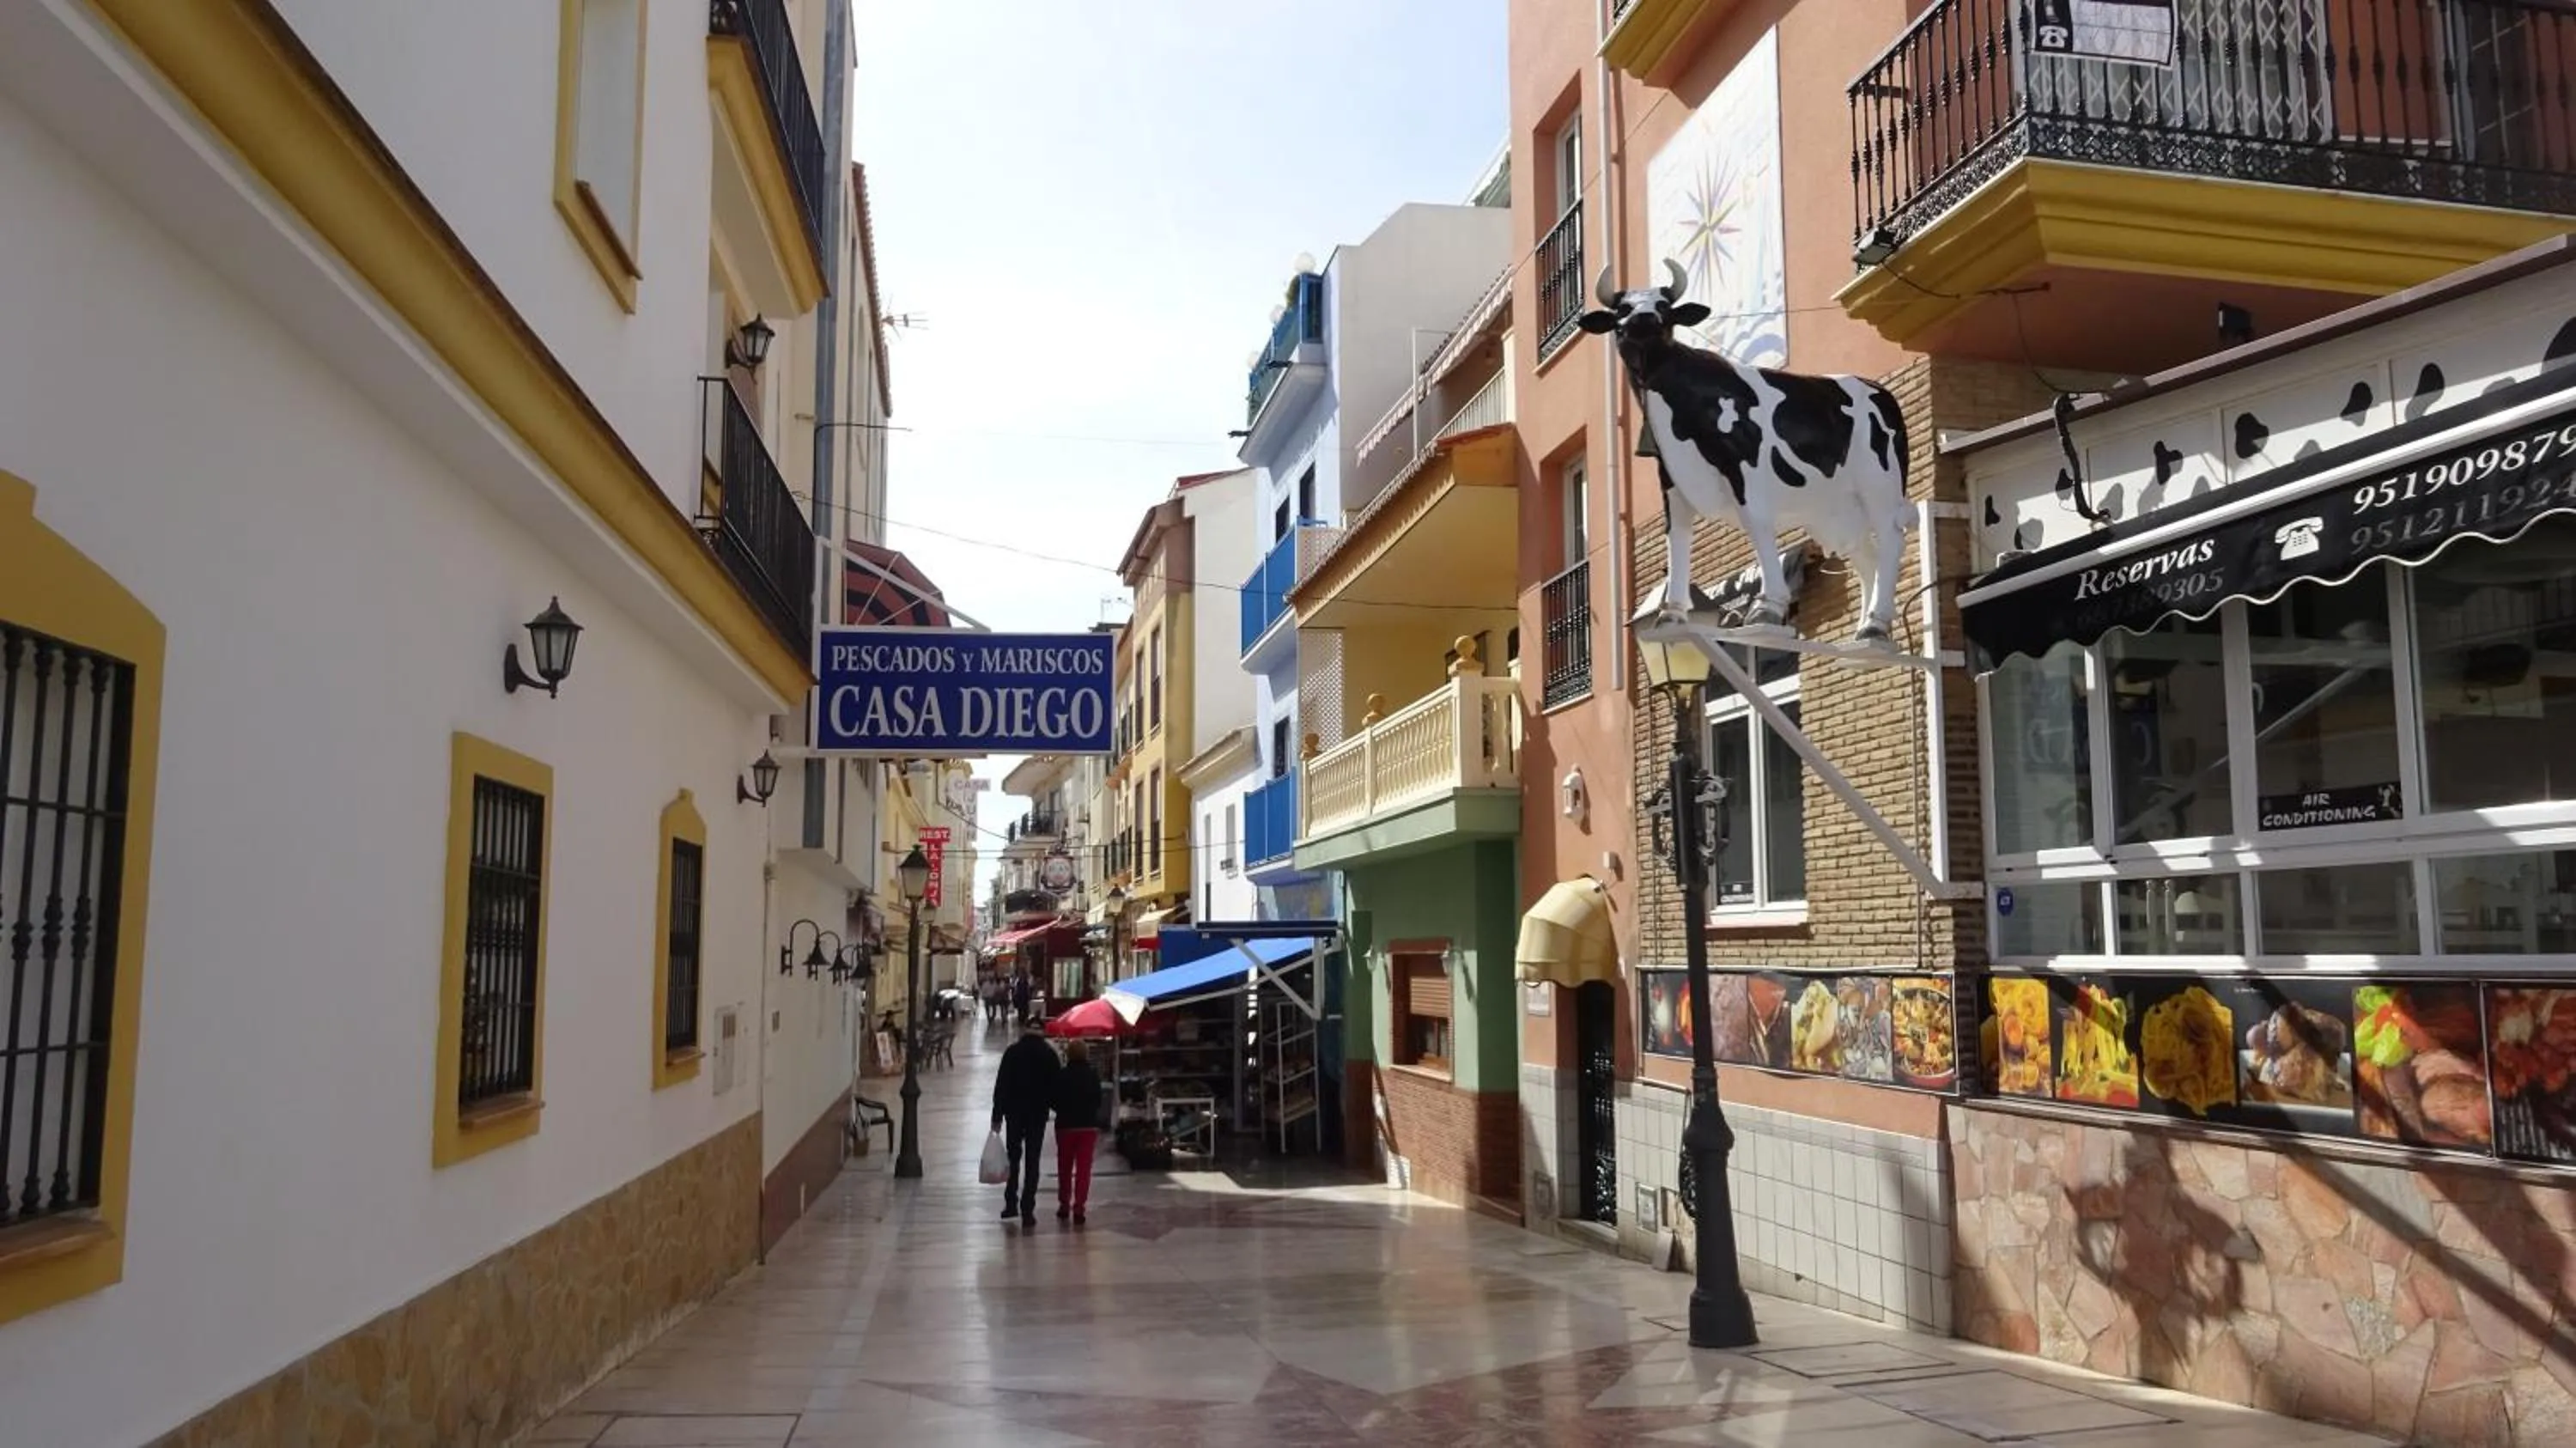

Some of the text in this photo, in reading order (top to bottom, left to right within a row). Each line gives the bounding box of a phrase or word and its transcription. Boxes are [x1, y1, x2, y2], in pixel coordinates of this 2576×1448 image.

[2352, 425, 2576, 515] 951909879
[2074, 538, 2215, 601] Reservas
[831, 646, 1103, 674] PESCADOS Y MARISCOS
[829, 685, 1103, 739] CASA DIEGO
[953, 779, 989, 791] CASA
[2302, 793, 2330, 806] AIR
[2263, 805, 2376, 826] CONDITIONING
